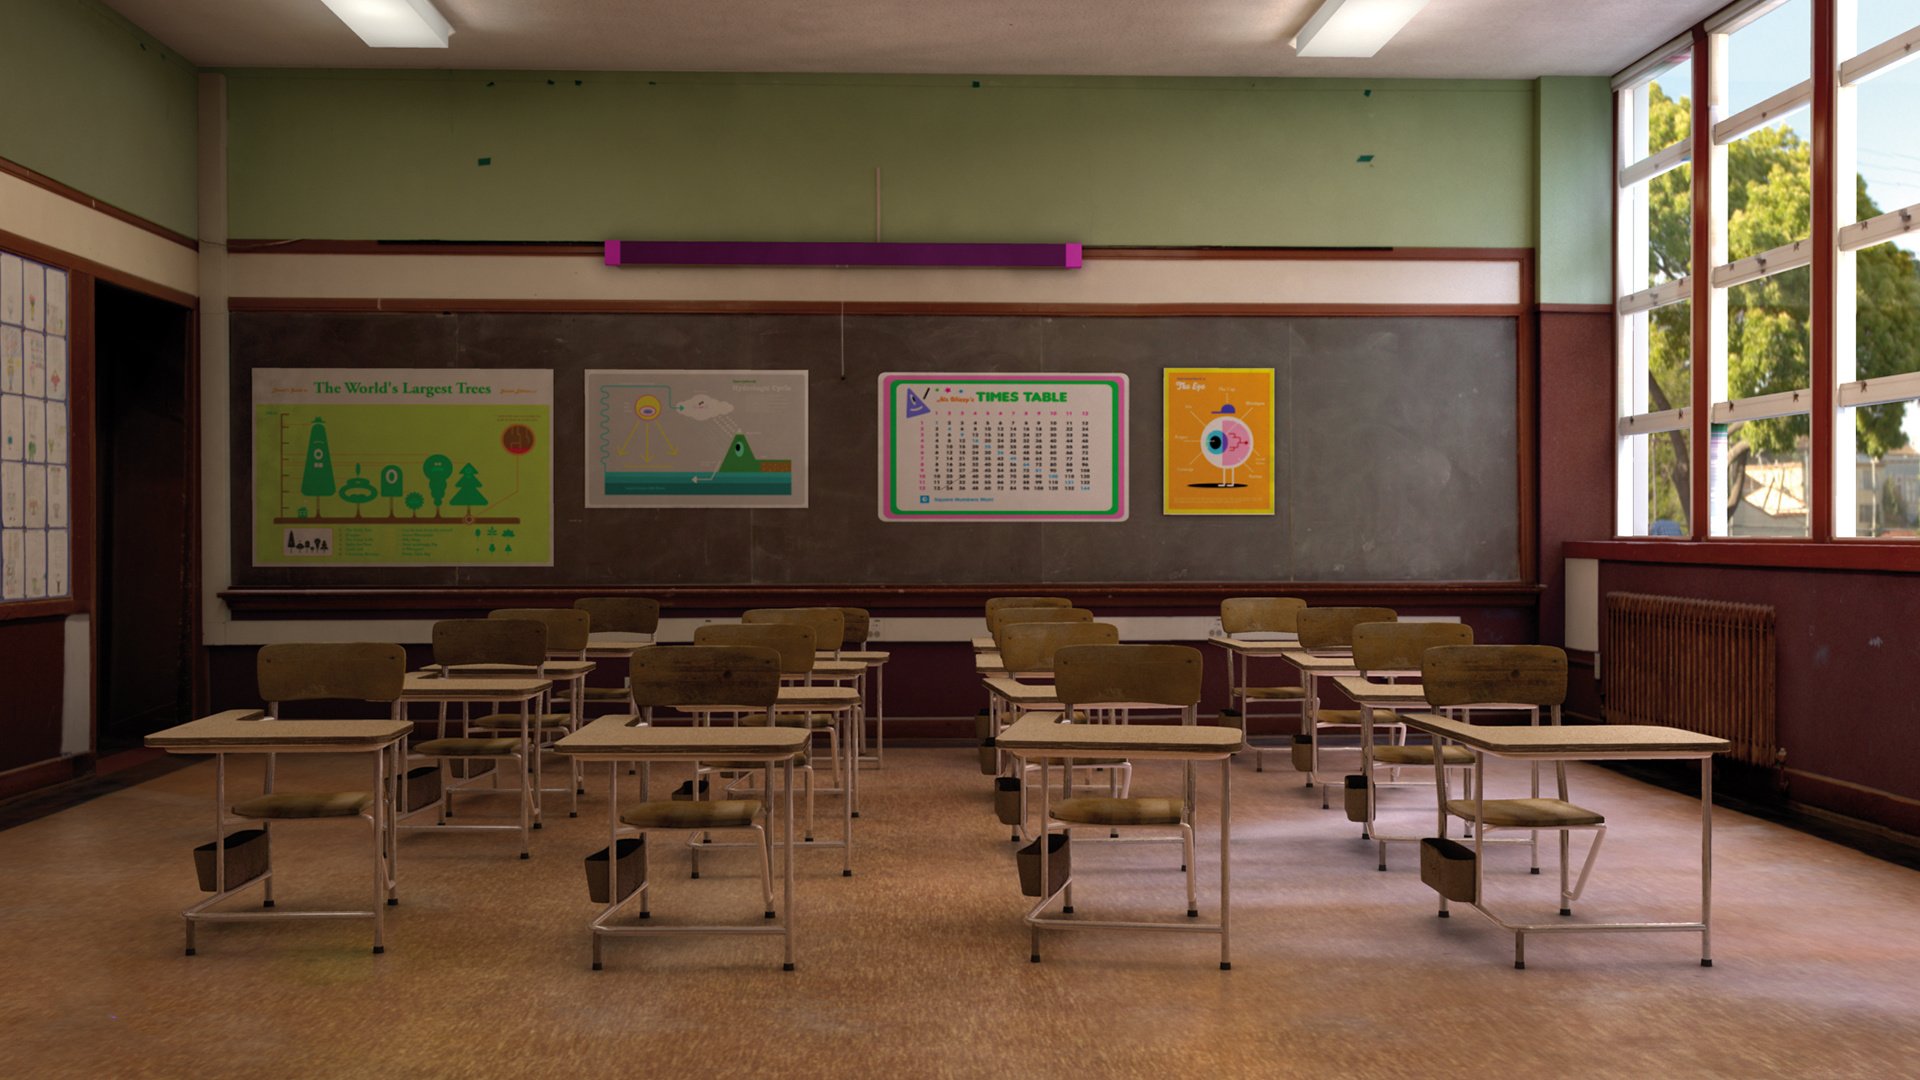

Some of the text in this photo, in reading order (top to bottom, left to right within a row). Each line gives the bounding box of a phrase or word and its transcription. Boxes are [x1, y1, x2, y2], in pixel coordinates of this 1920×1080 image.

[314, 382, 341, 394] The
[344, 382, 398, 394] World's
[402, 382, 452, 398] Largest
[456, 382, 491, 394] Trees
[1176, 382, 1206, 392] The Eye
[976, 392, 1018, 402] TIMES
[1023, 392, 1067, 402] TABLE
